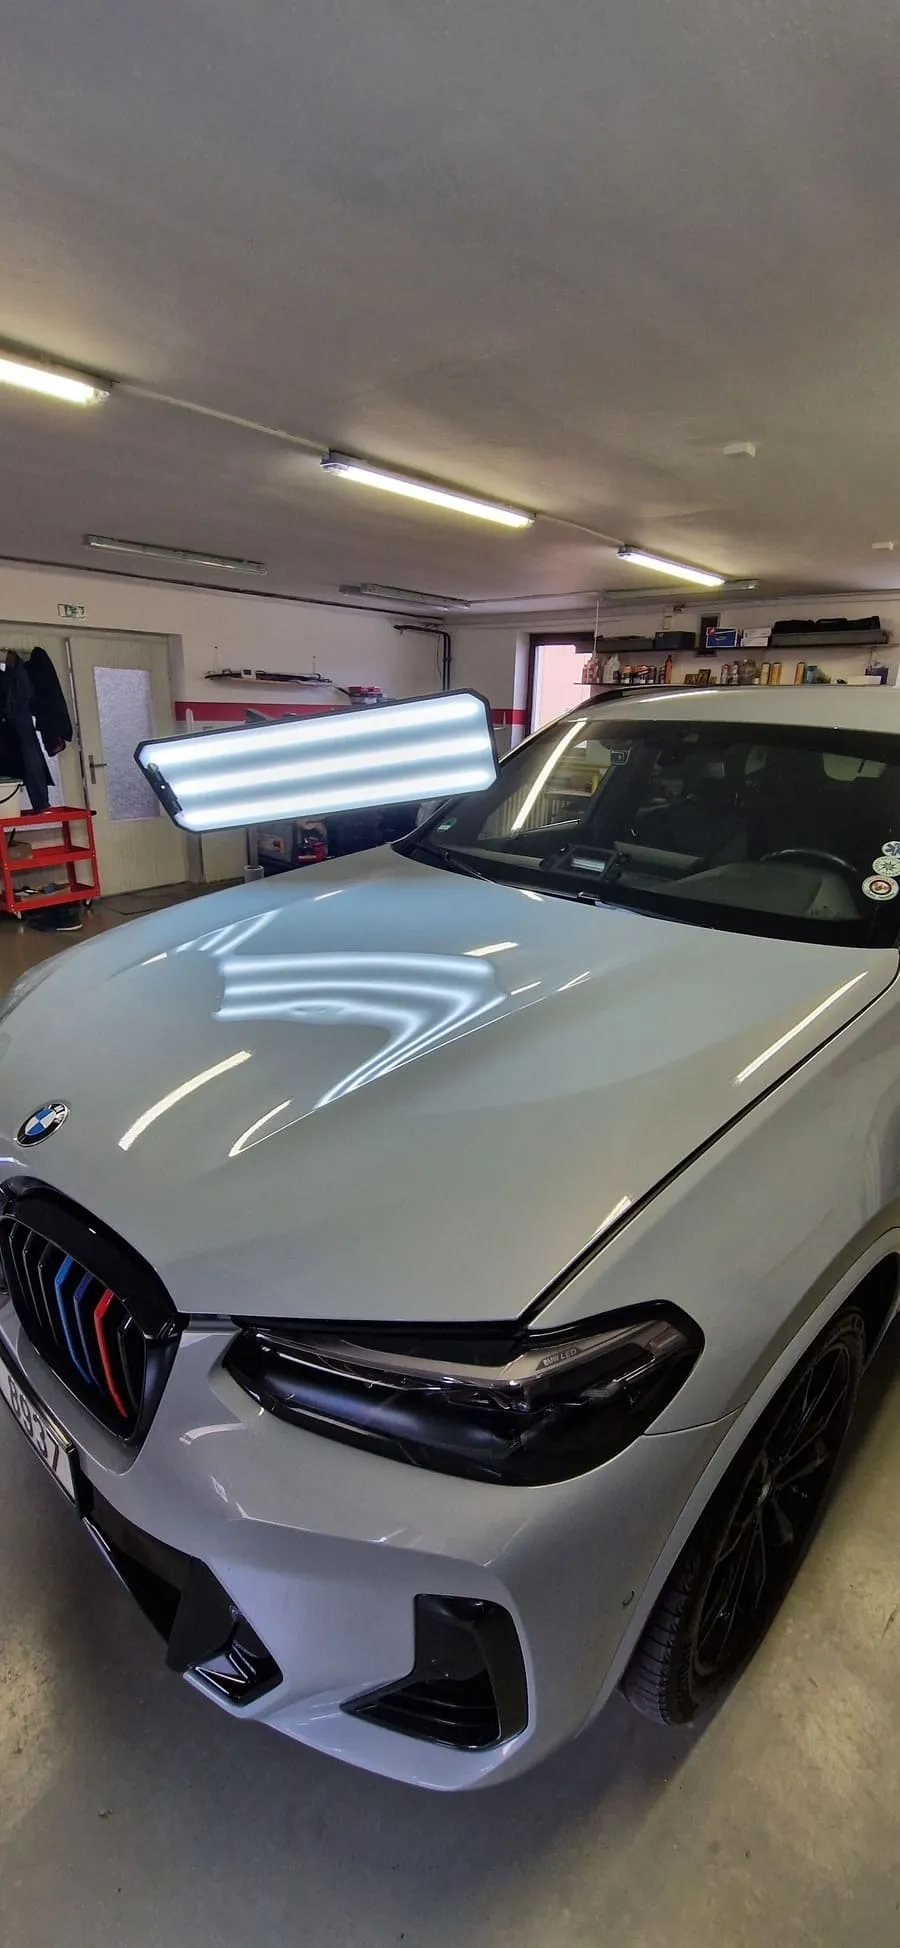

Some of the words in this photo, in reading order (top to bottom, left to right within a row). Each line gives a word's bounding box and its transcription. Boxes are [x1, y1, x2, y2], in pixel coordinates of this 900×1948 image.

[543, 1352, 559, 1366] BMW
[560, 1348, 577, 1359] LED
[8, 1375, 59, 1472] 8937
